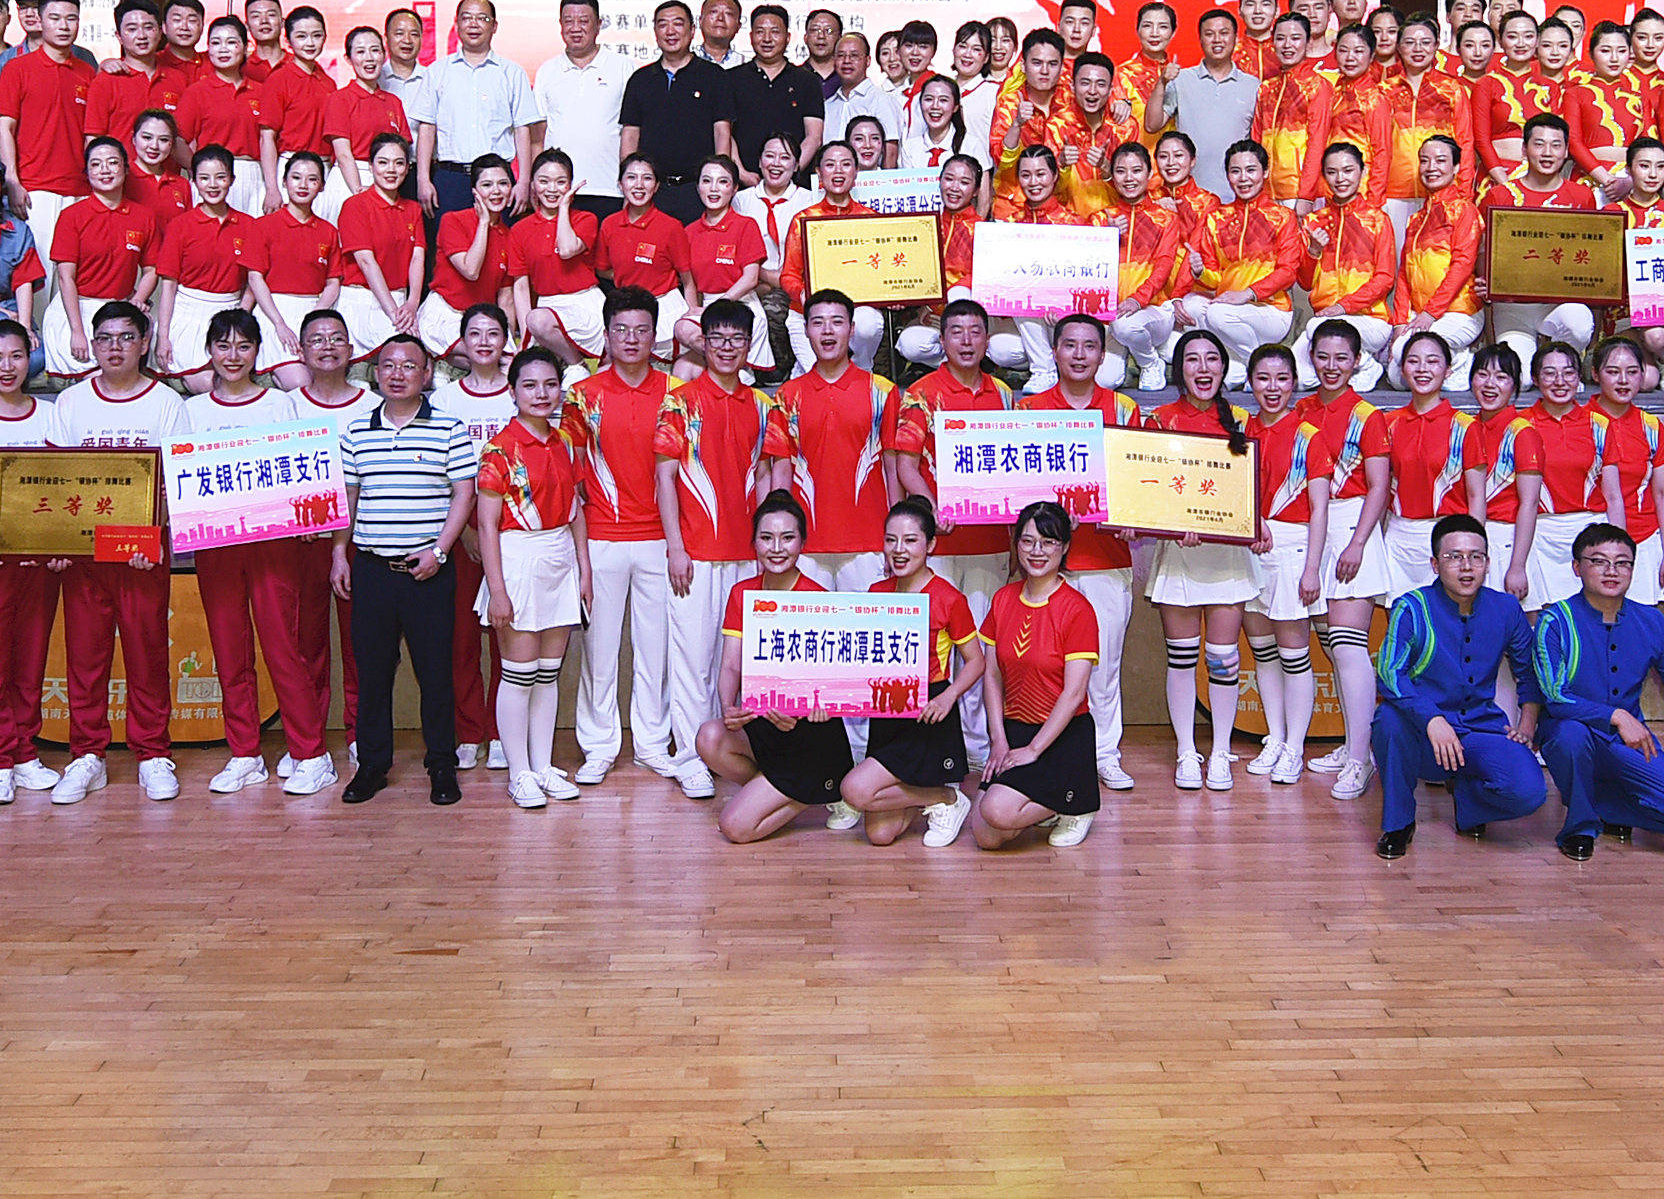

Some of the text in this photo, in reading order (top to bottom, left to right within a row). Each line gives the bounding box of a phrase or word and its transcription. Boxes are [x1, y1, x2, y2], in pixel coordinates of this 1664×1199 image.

[841, 251, 908, 270] 一等奖
[1523, 247, 1591, 266] 二等奖
[953, 442, 1089, 474] 湘潭农商银行
[177, 450, 331, 501] 广发银行湘潭支行
[1140, 474, 1217, 497] 一等奖
[32, 495, 115, 517] 三等奖
[753, 628, 920, 665] 上海农商行湘潭县支行
